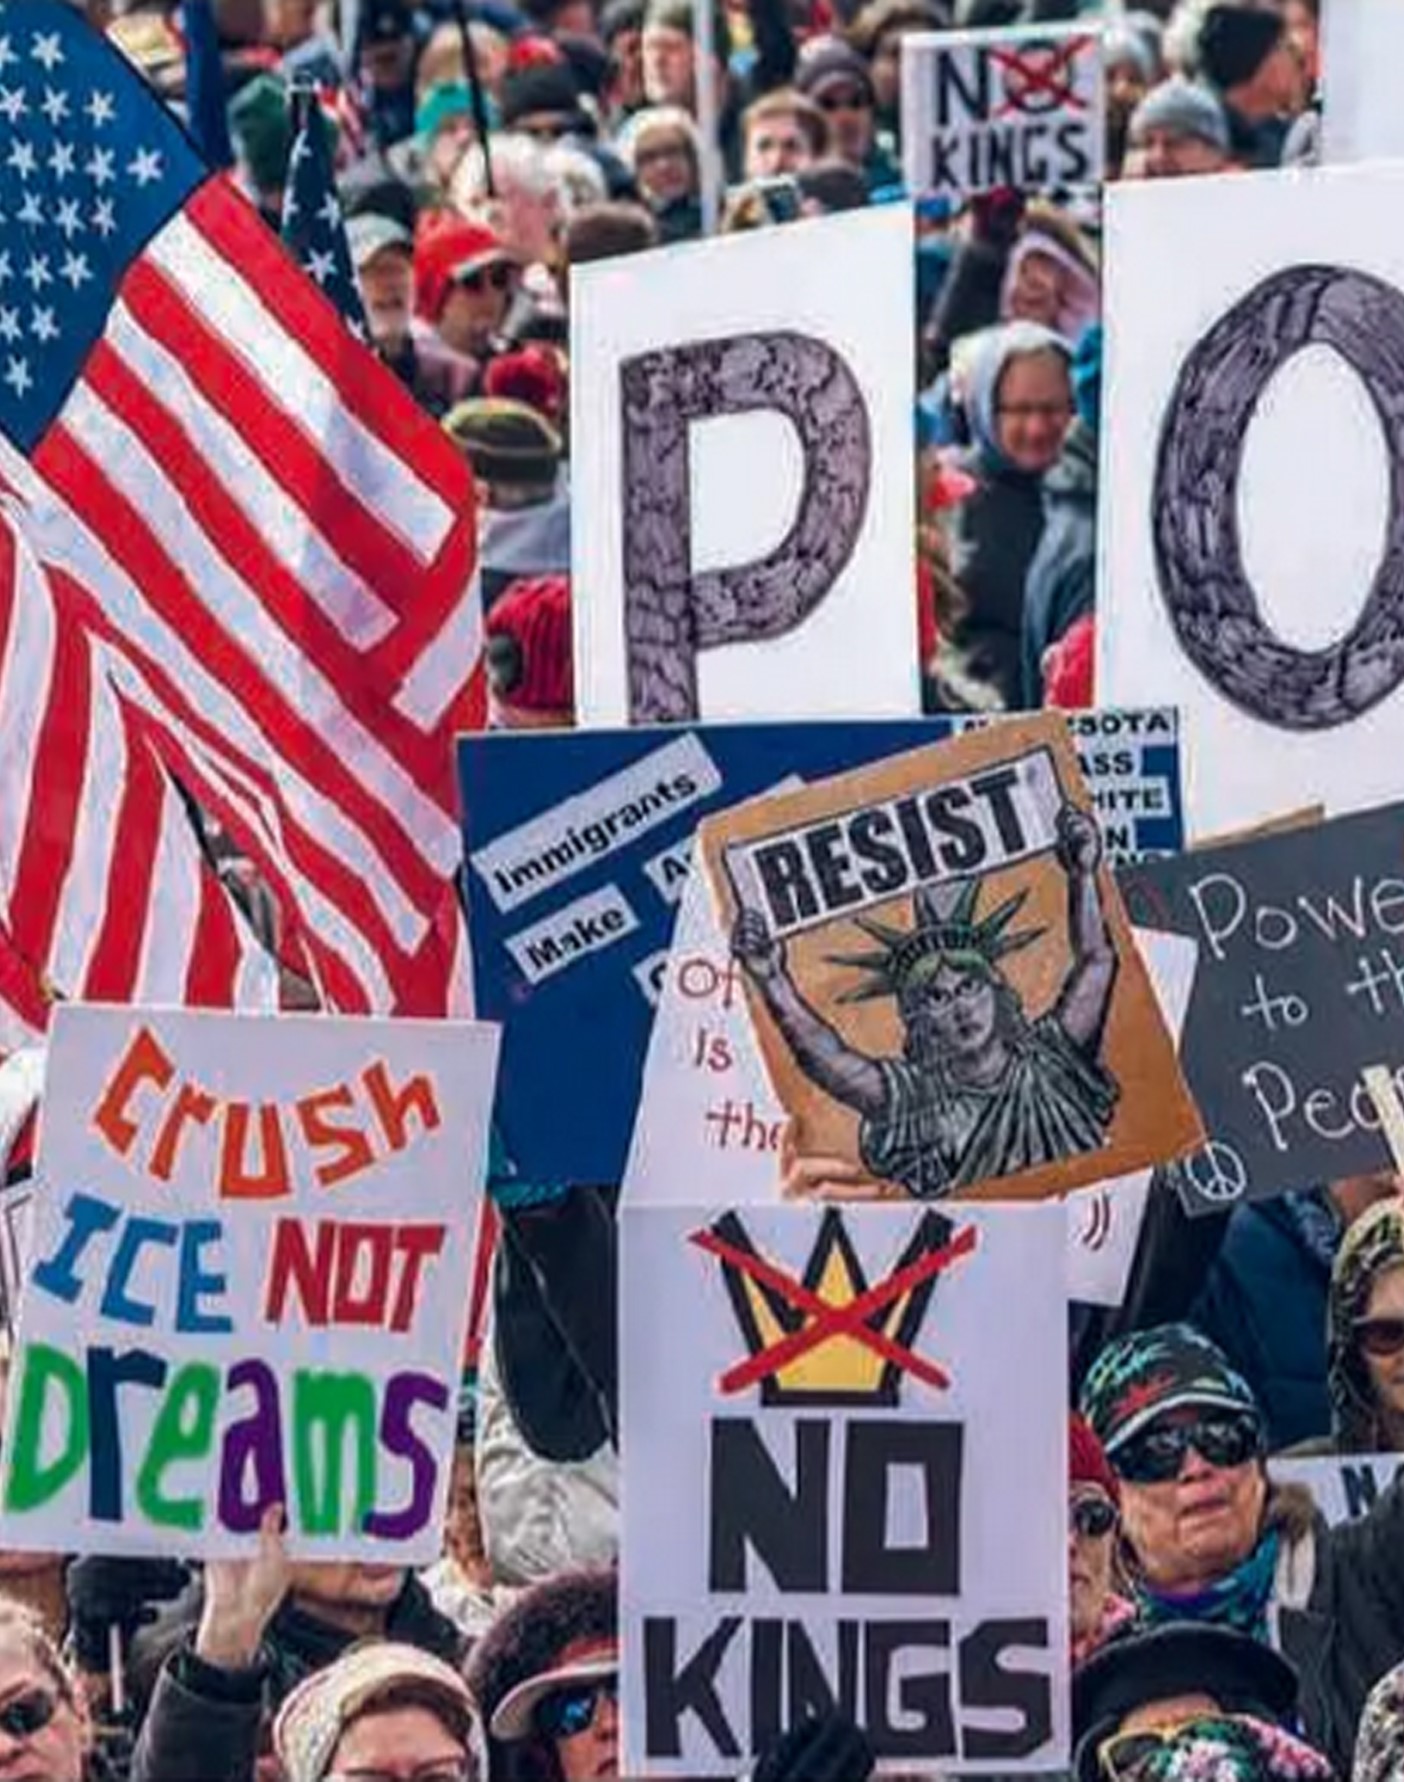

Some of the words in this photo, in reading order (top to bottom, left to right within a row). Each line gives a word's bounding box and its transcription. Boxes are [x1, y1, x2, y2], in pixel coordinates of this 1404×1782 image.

[934, 38, 1080, 127] NO
[930, 125, 1090, 191] KINGS
[494, 774, 697, 894] Immigrants
[752, 767, 1032, 935] RESIST
[524, 908, 626, 971] Make
[1240, 975, 1309, 1029] to
[93, 1025, 441, 1199] Crush
[32, 1193, 234, 1333] ICE
[266, 1217, 447, 1332] NOT
[8, 1343, 451, 1541] Dreams
[707, 1417, 965, 1597] NO
[642, 1614, 1055, 1760] KINGS
